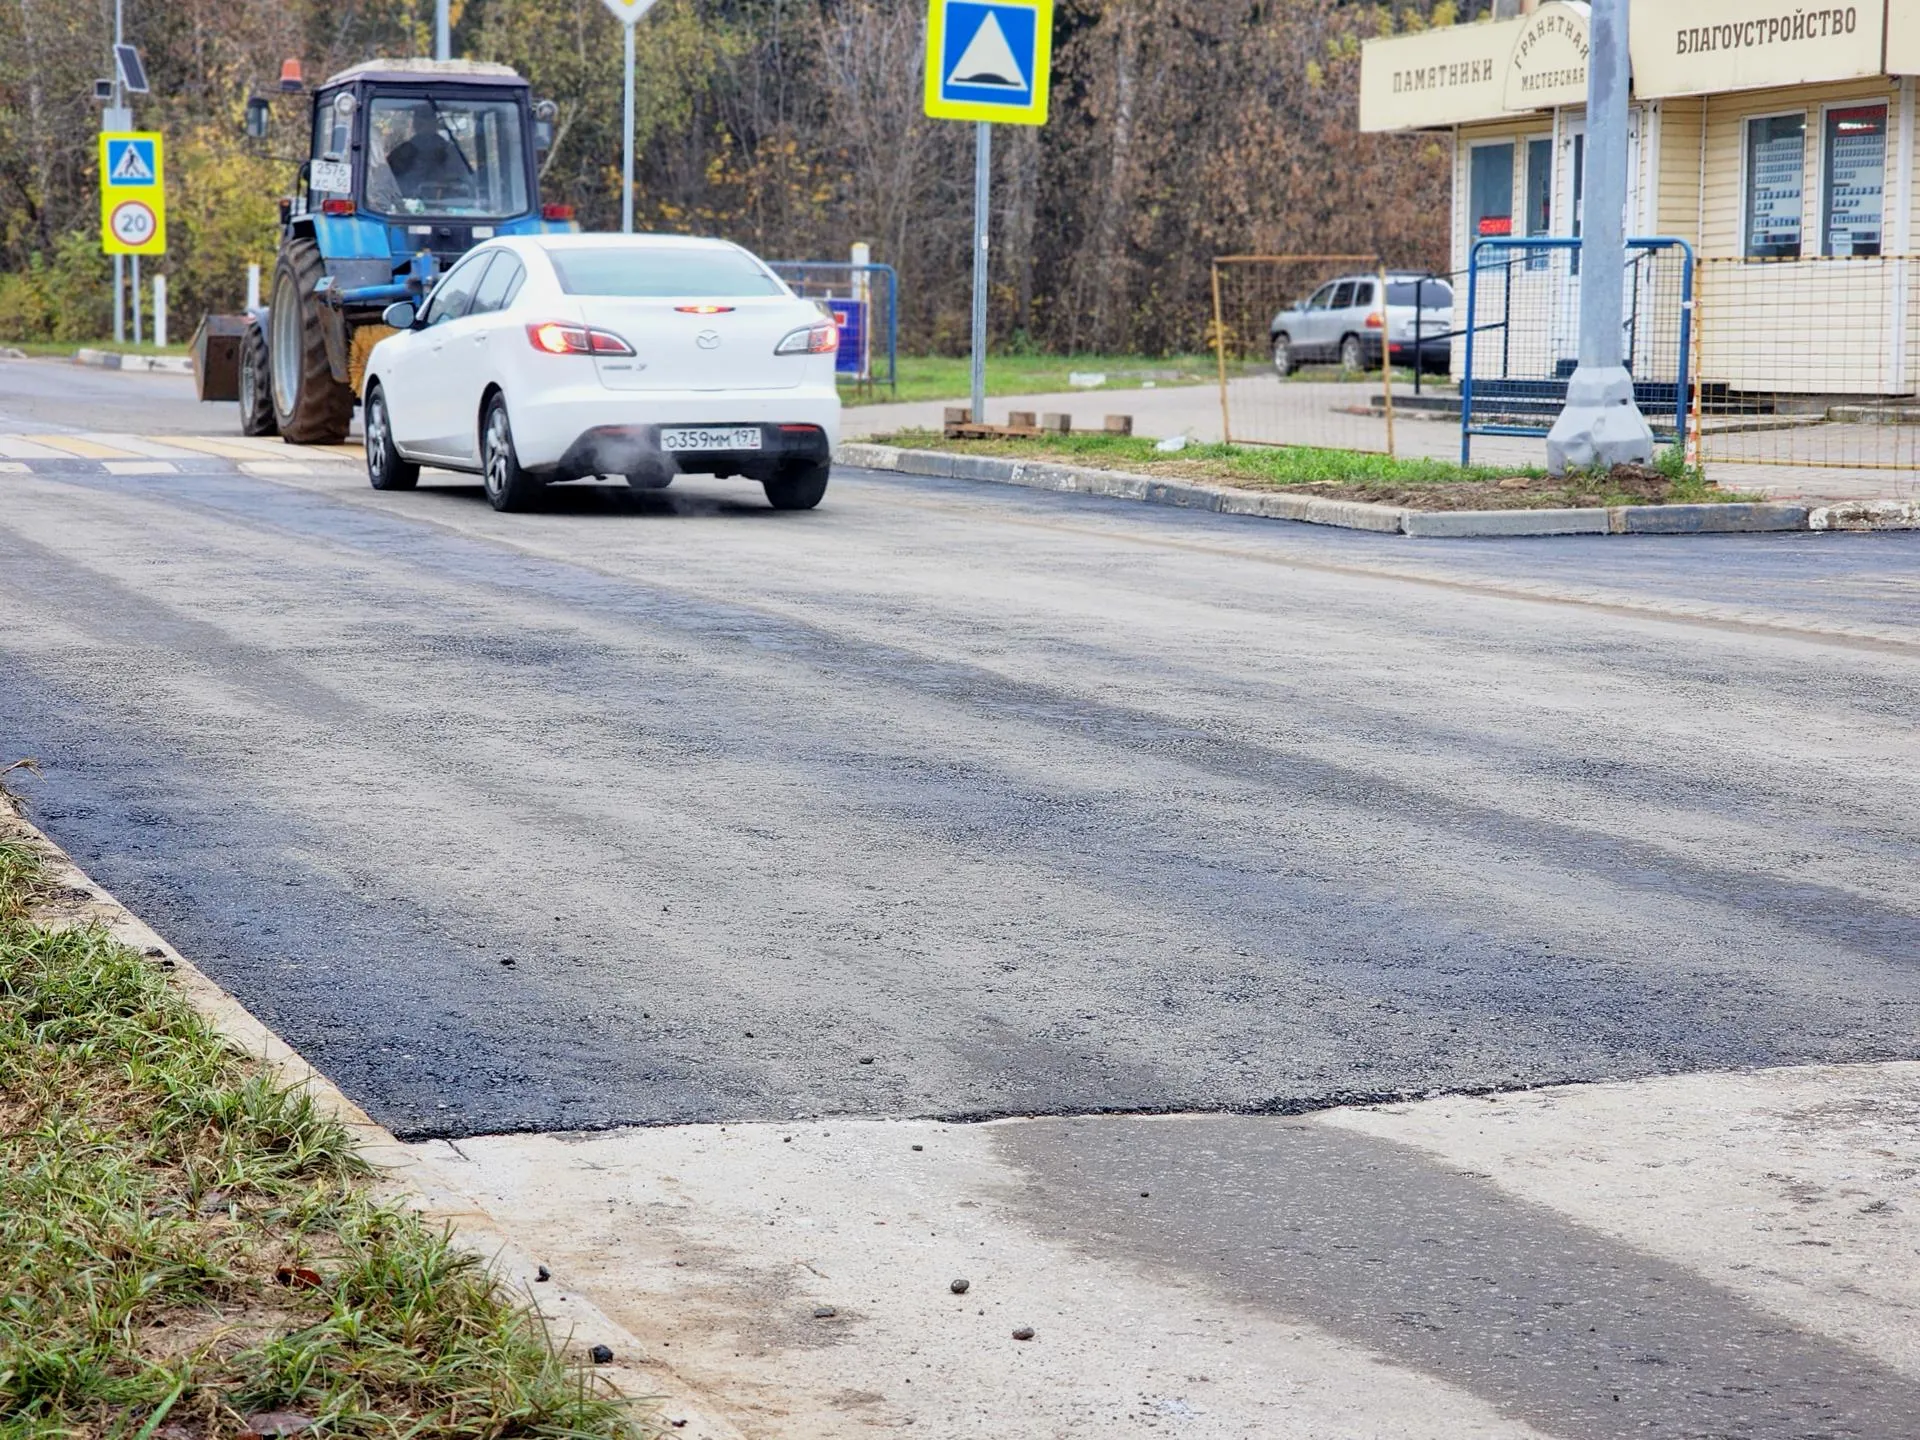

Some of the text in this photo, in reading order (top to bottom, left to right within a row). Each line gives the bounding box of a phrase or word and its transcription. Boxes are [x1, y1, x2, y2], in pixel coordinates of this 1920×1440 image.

[1676, 6, 1857, 55] БЛАГОУСТРОЙСТВО
[1392, 58, 1494, 94] ПАМЯТНИКИ
[1520, 67, 1585, 92] МАСТЕРСКАЯ
[120, 213, 148, 233] 20
[664, 429, 757, 448] О359ММ 197
